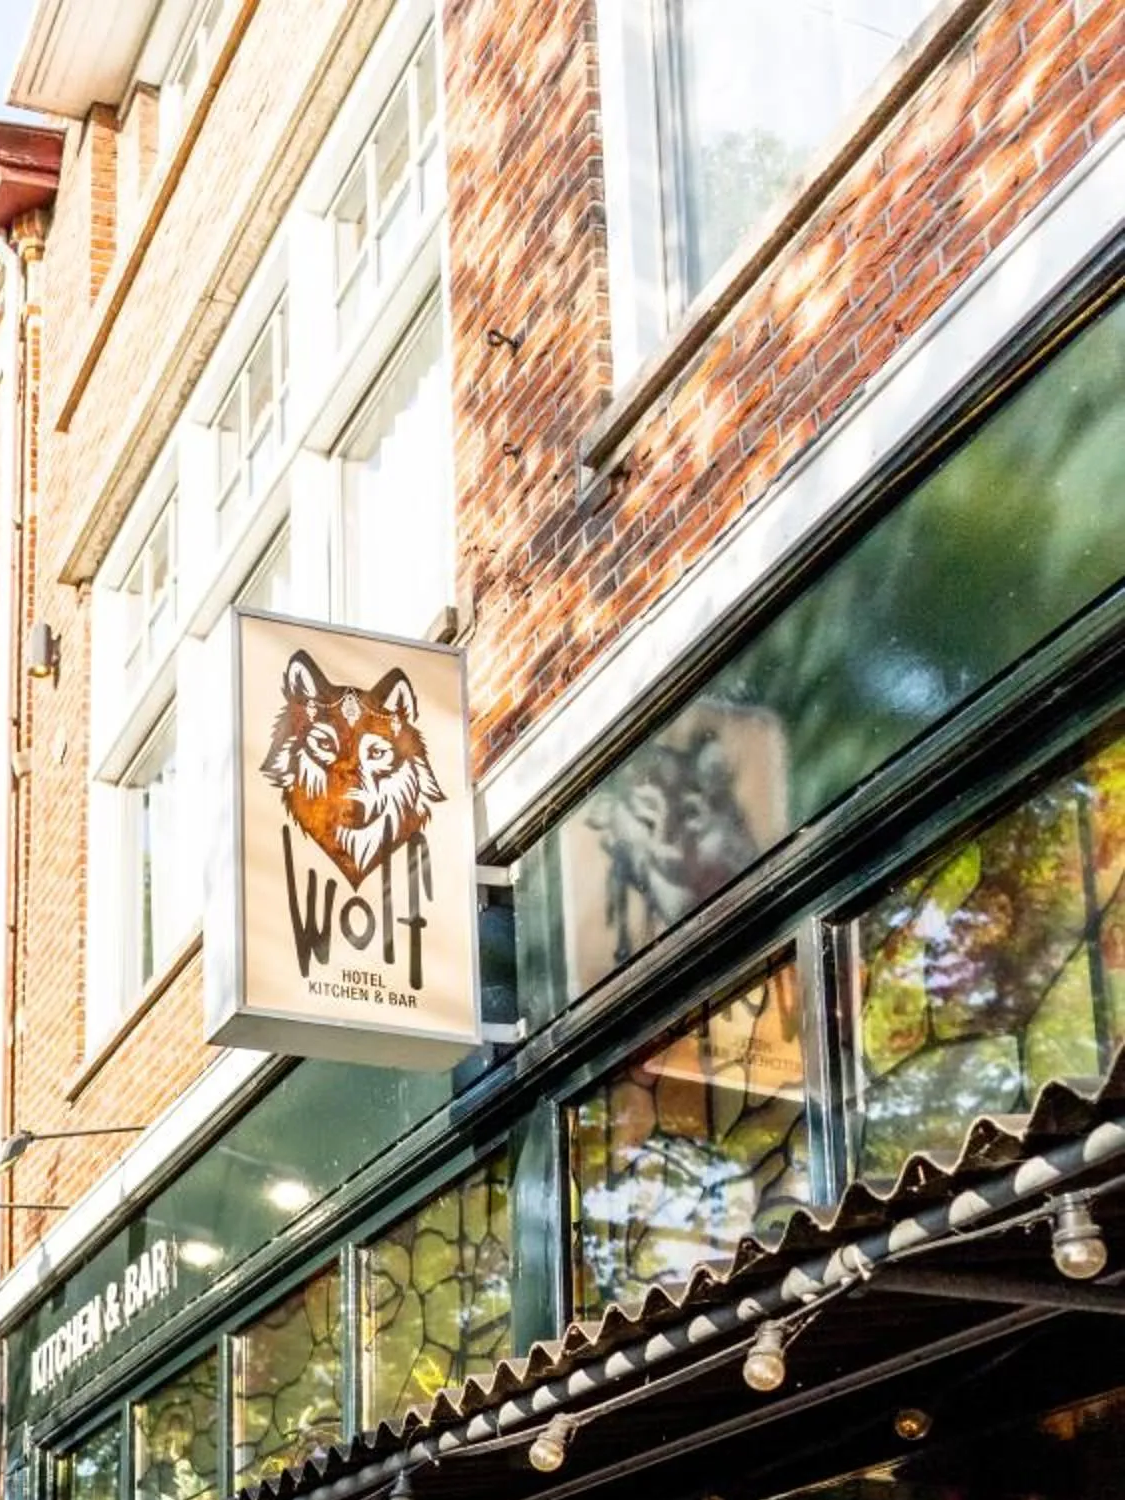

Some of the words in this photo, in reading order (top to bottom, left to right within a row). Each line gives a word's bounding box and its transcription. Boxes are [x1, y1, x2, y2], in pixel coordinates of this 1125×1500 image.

[342, 969, 386, 988] HOTEL
[308, 980, 369, 1001] KITCHEN
[374, 990, 383, 1005] &
[388, 991, 417, 1009] BAR
[31, 1294, 102, 1396] KITCHEN
[105, 1282, 120, 1335] &
[124, 1239, 169, 1318] BAR
